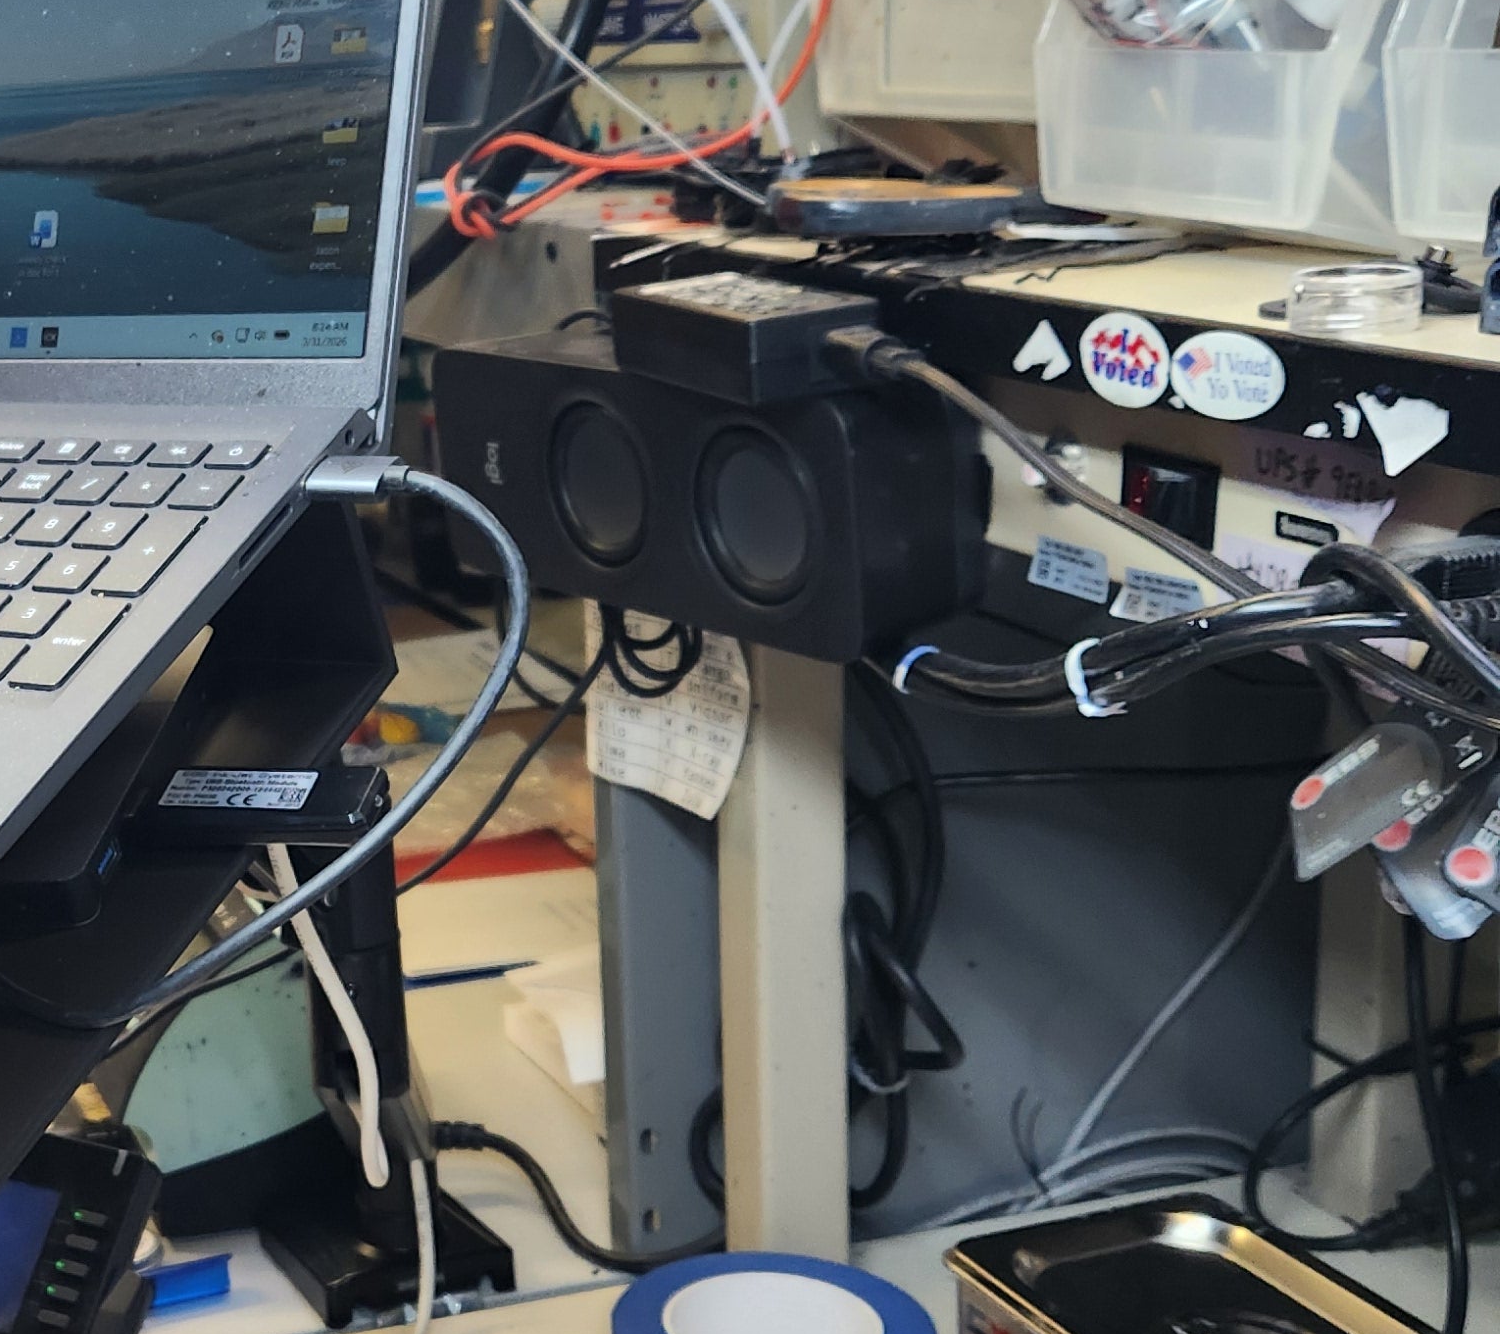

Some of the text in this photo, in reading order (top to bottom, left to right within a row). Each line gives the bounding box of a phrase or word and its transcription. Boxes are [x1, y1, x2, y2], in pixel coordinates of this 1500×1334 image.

[1092, 350, 1157, 388] Voted
[1214, 352, 1272, 377] I Voted
[1207, 378, 1229, 400] Yo
[26, 472, 51, 481] num
[18, 481, 41, 490] lock
[45, 518, 59, 529] 8
[101, 521, 116, 533] 9
[4, 560, 20, 571] 5
[63, 564, 77, 575] 6
[21, 607, 37, 618] 3
[52, 636, 86, 647] enter
[226, 794, 257, 806] CE
